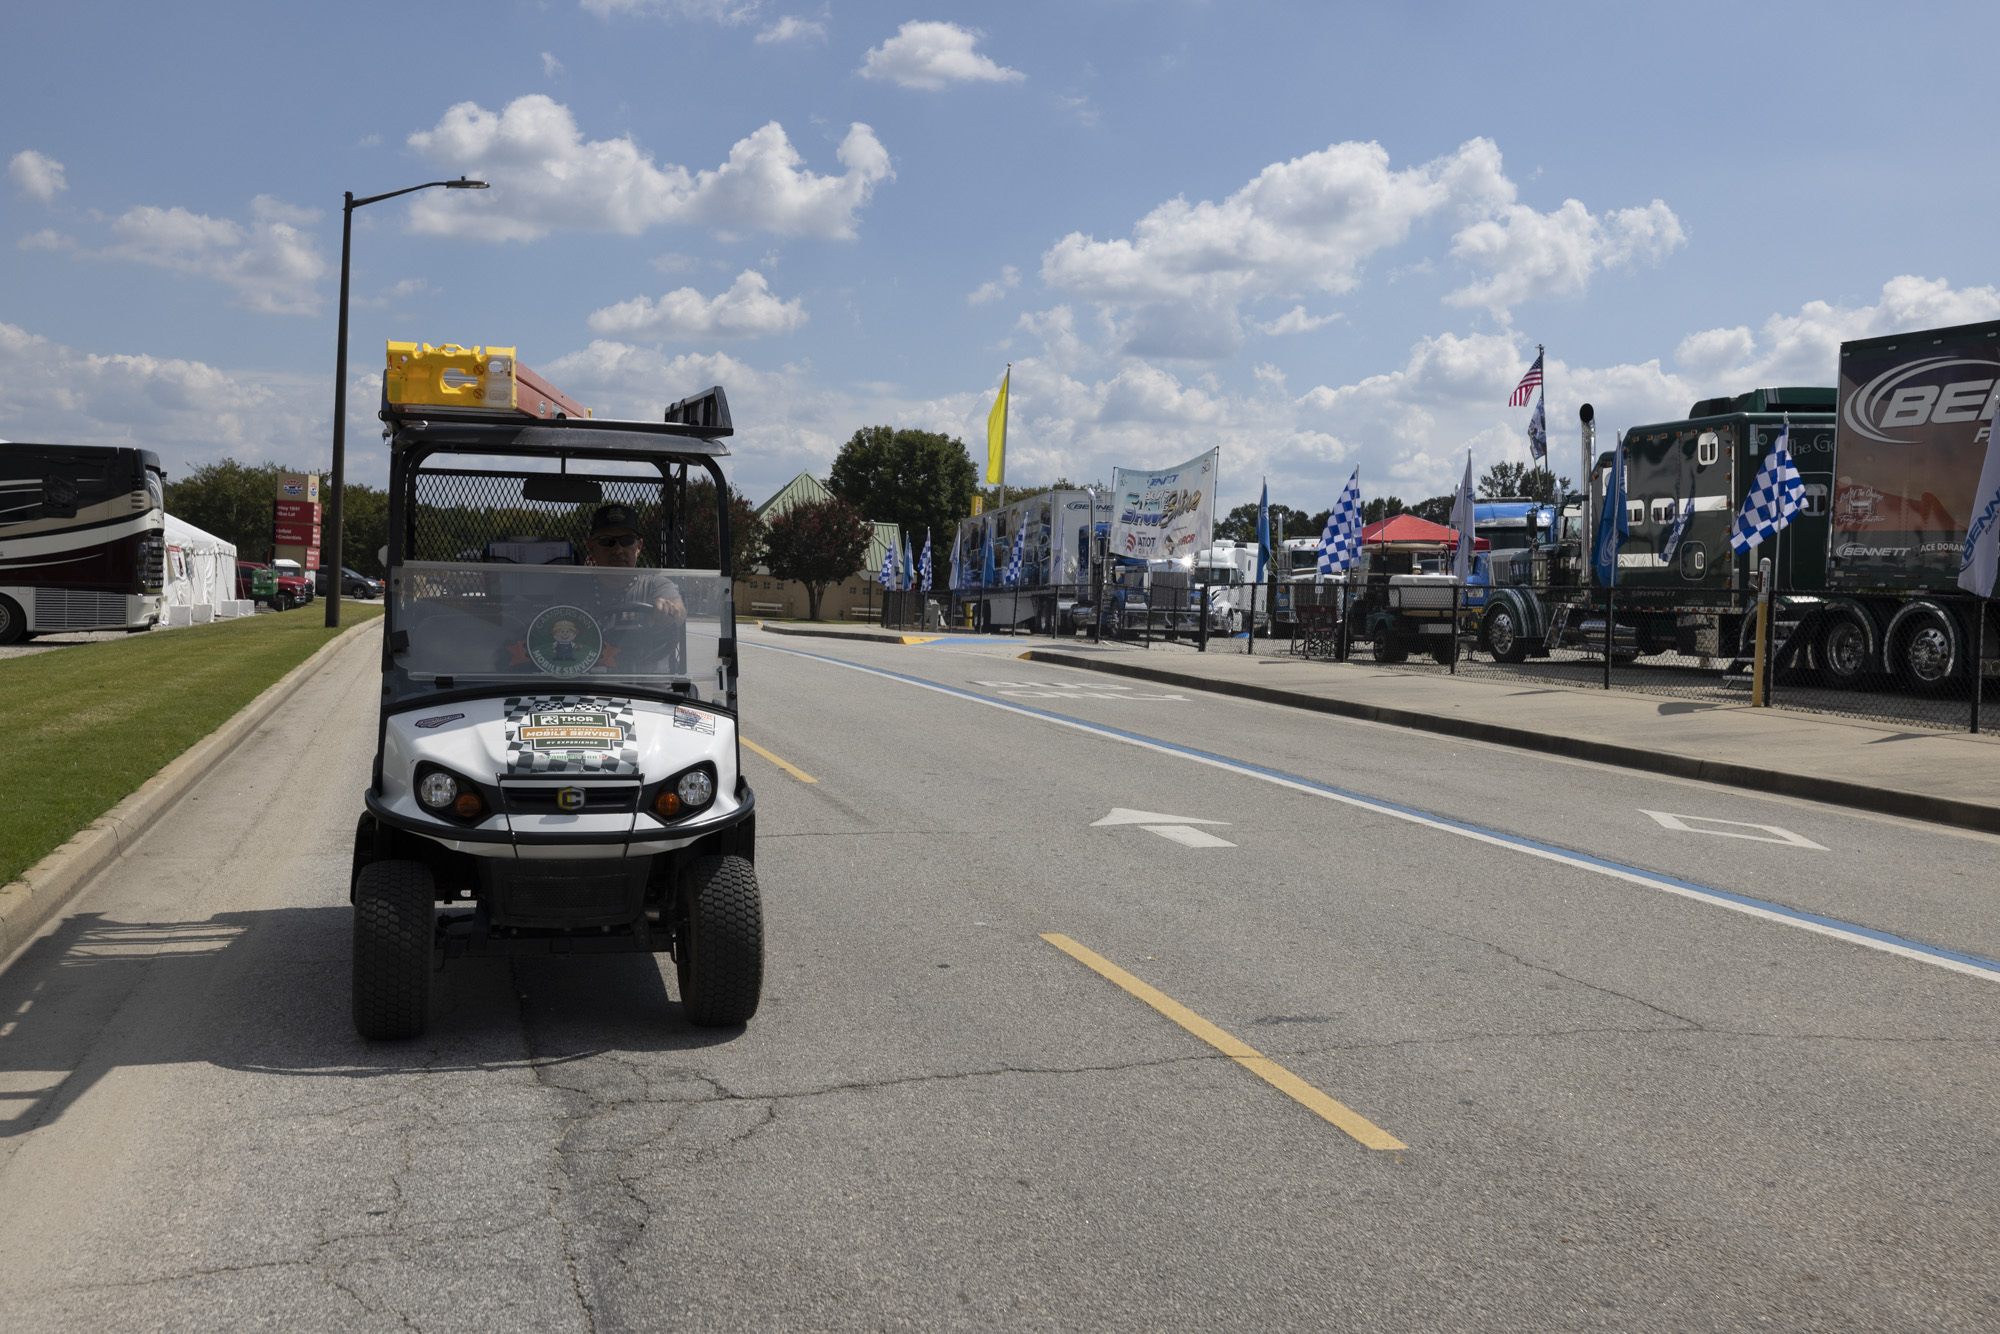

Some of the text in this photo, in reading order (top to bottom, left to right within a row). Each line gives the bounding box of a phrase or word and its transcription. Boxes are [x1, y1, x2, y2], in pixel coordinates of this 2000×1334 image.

[1843, 547, 1912, 557] BENNETT
[1920, 543, 1965, 553] ACE DORAN
[535, 608, 594, 630] CAMPERS INN
[532, 649, 597, 675] MOBILE SERVICE
[997, 690, 1192, 702] ONLY
